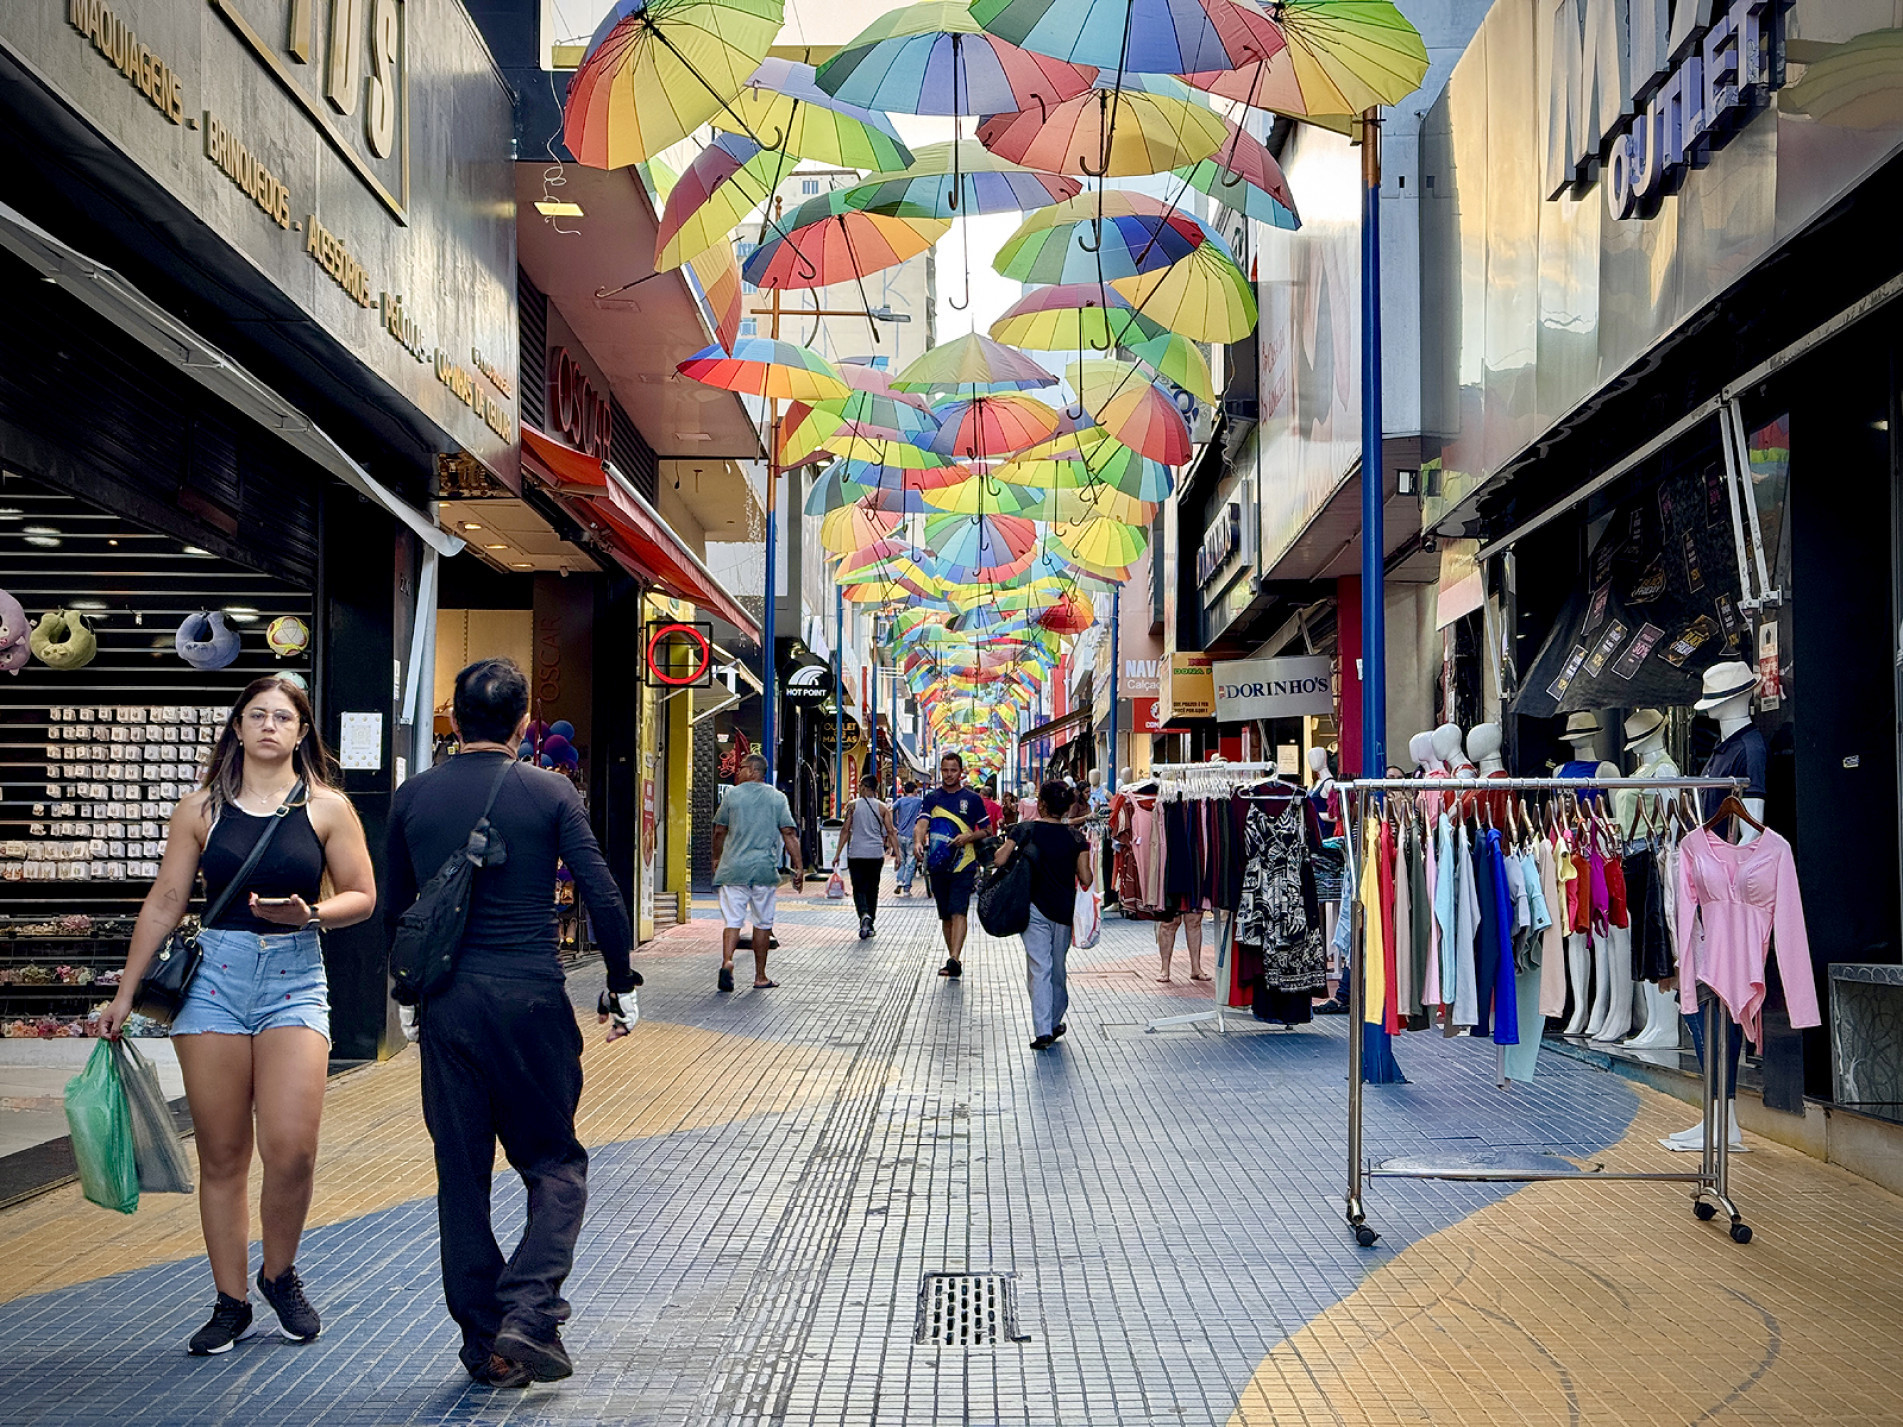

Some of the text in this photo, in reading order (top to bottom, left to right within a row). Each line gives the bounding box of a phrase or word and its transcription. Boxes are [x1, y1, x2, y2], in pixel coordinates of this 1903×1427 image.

[1607, 0, 1764, 220] OUTLET
[70, 0, 184, 125] MAQUIAGENS
[204, 110, 290, 230] BRINQUEDOS
[306, 214, 370, 308] ACESSÓRIOS
[556, 346, 612, 460] OSCAR
[540, 617, 560, 702] OSCAR
[786, 689, 827, 697] HOT POINT
[1226, 677, 1329, 699] DORINHO'S
[824, 722, 856, 730] OULET
